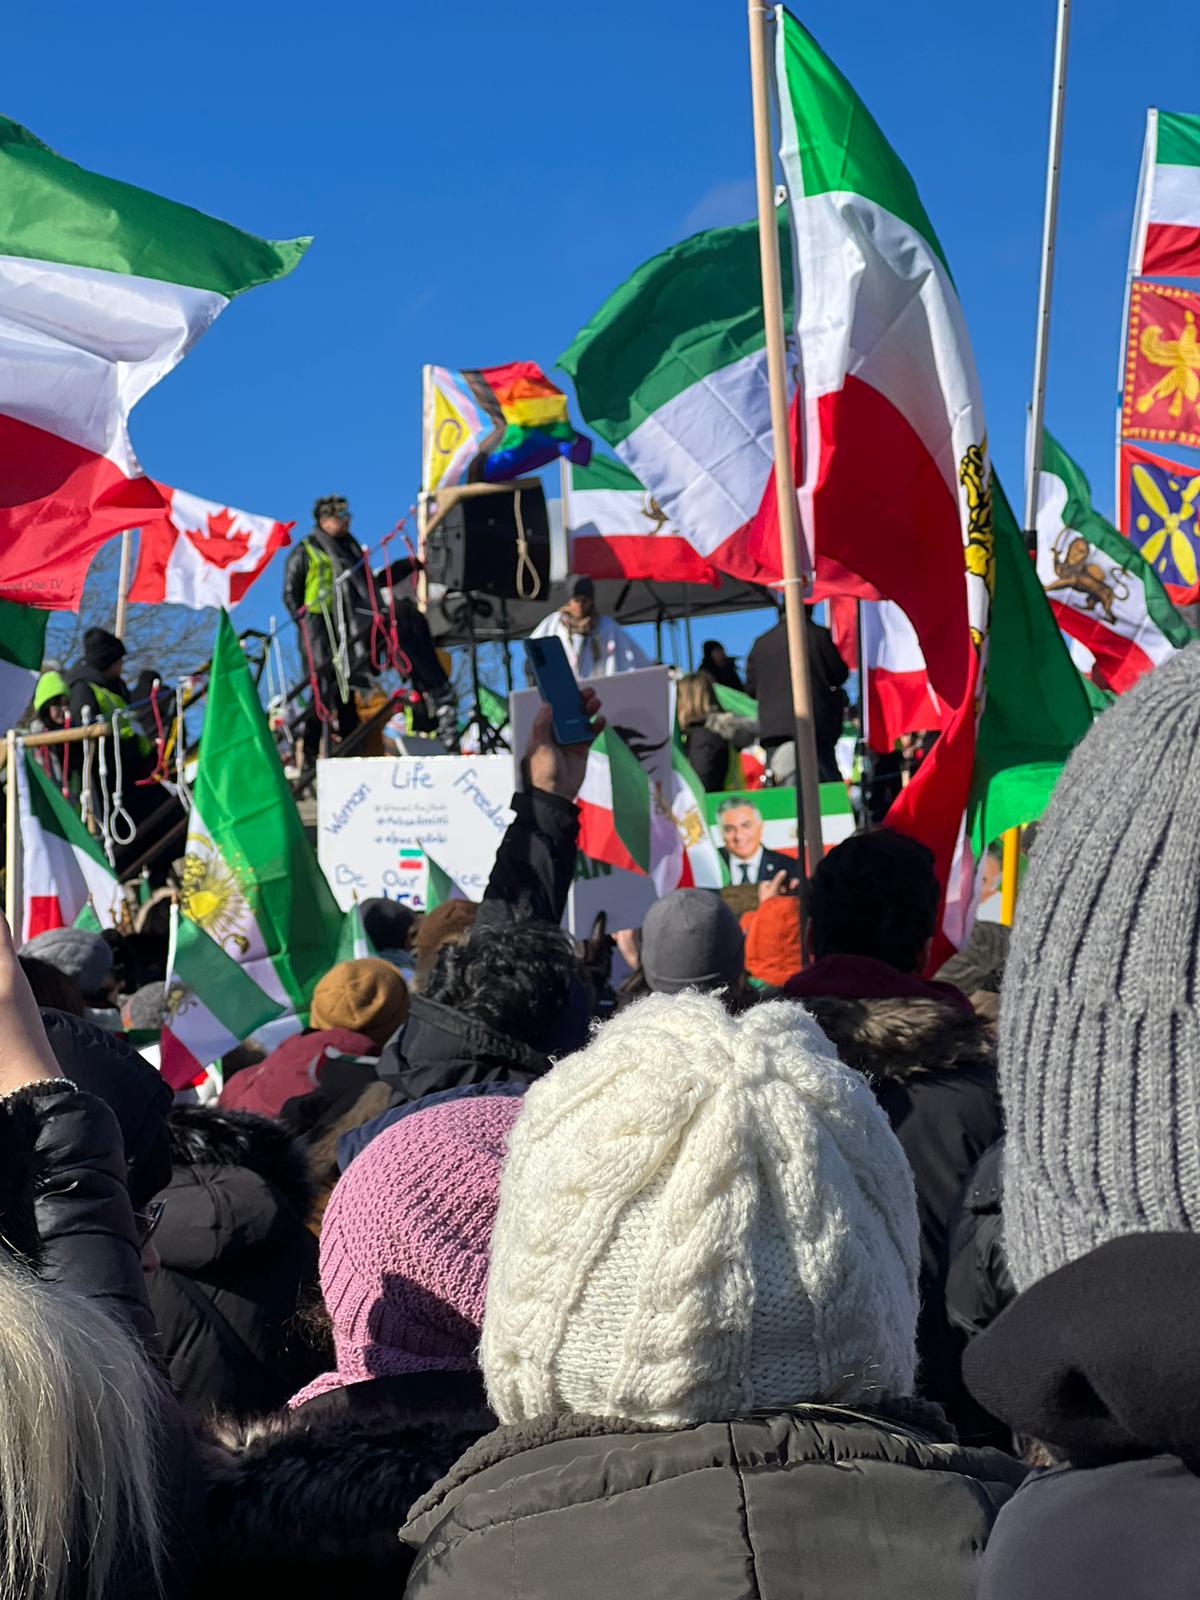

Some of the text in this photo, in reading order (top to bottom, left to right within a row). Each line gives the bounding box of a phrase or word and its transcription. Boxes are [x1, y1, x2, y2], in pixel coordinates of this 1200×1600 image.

[391, 761, 435, 790] Life
[324, 783, 371, 835] Woman
[453, 768, 507, 832] Freedo
[334, 863, 367, 887] Be
[382, 869, 420, 888] Our
[576, 849, 612, 880] AN
